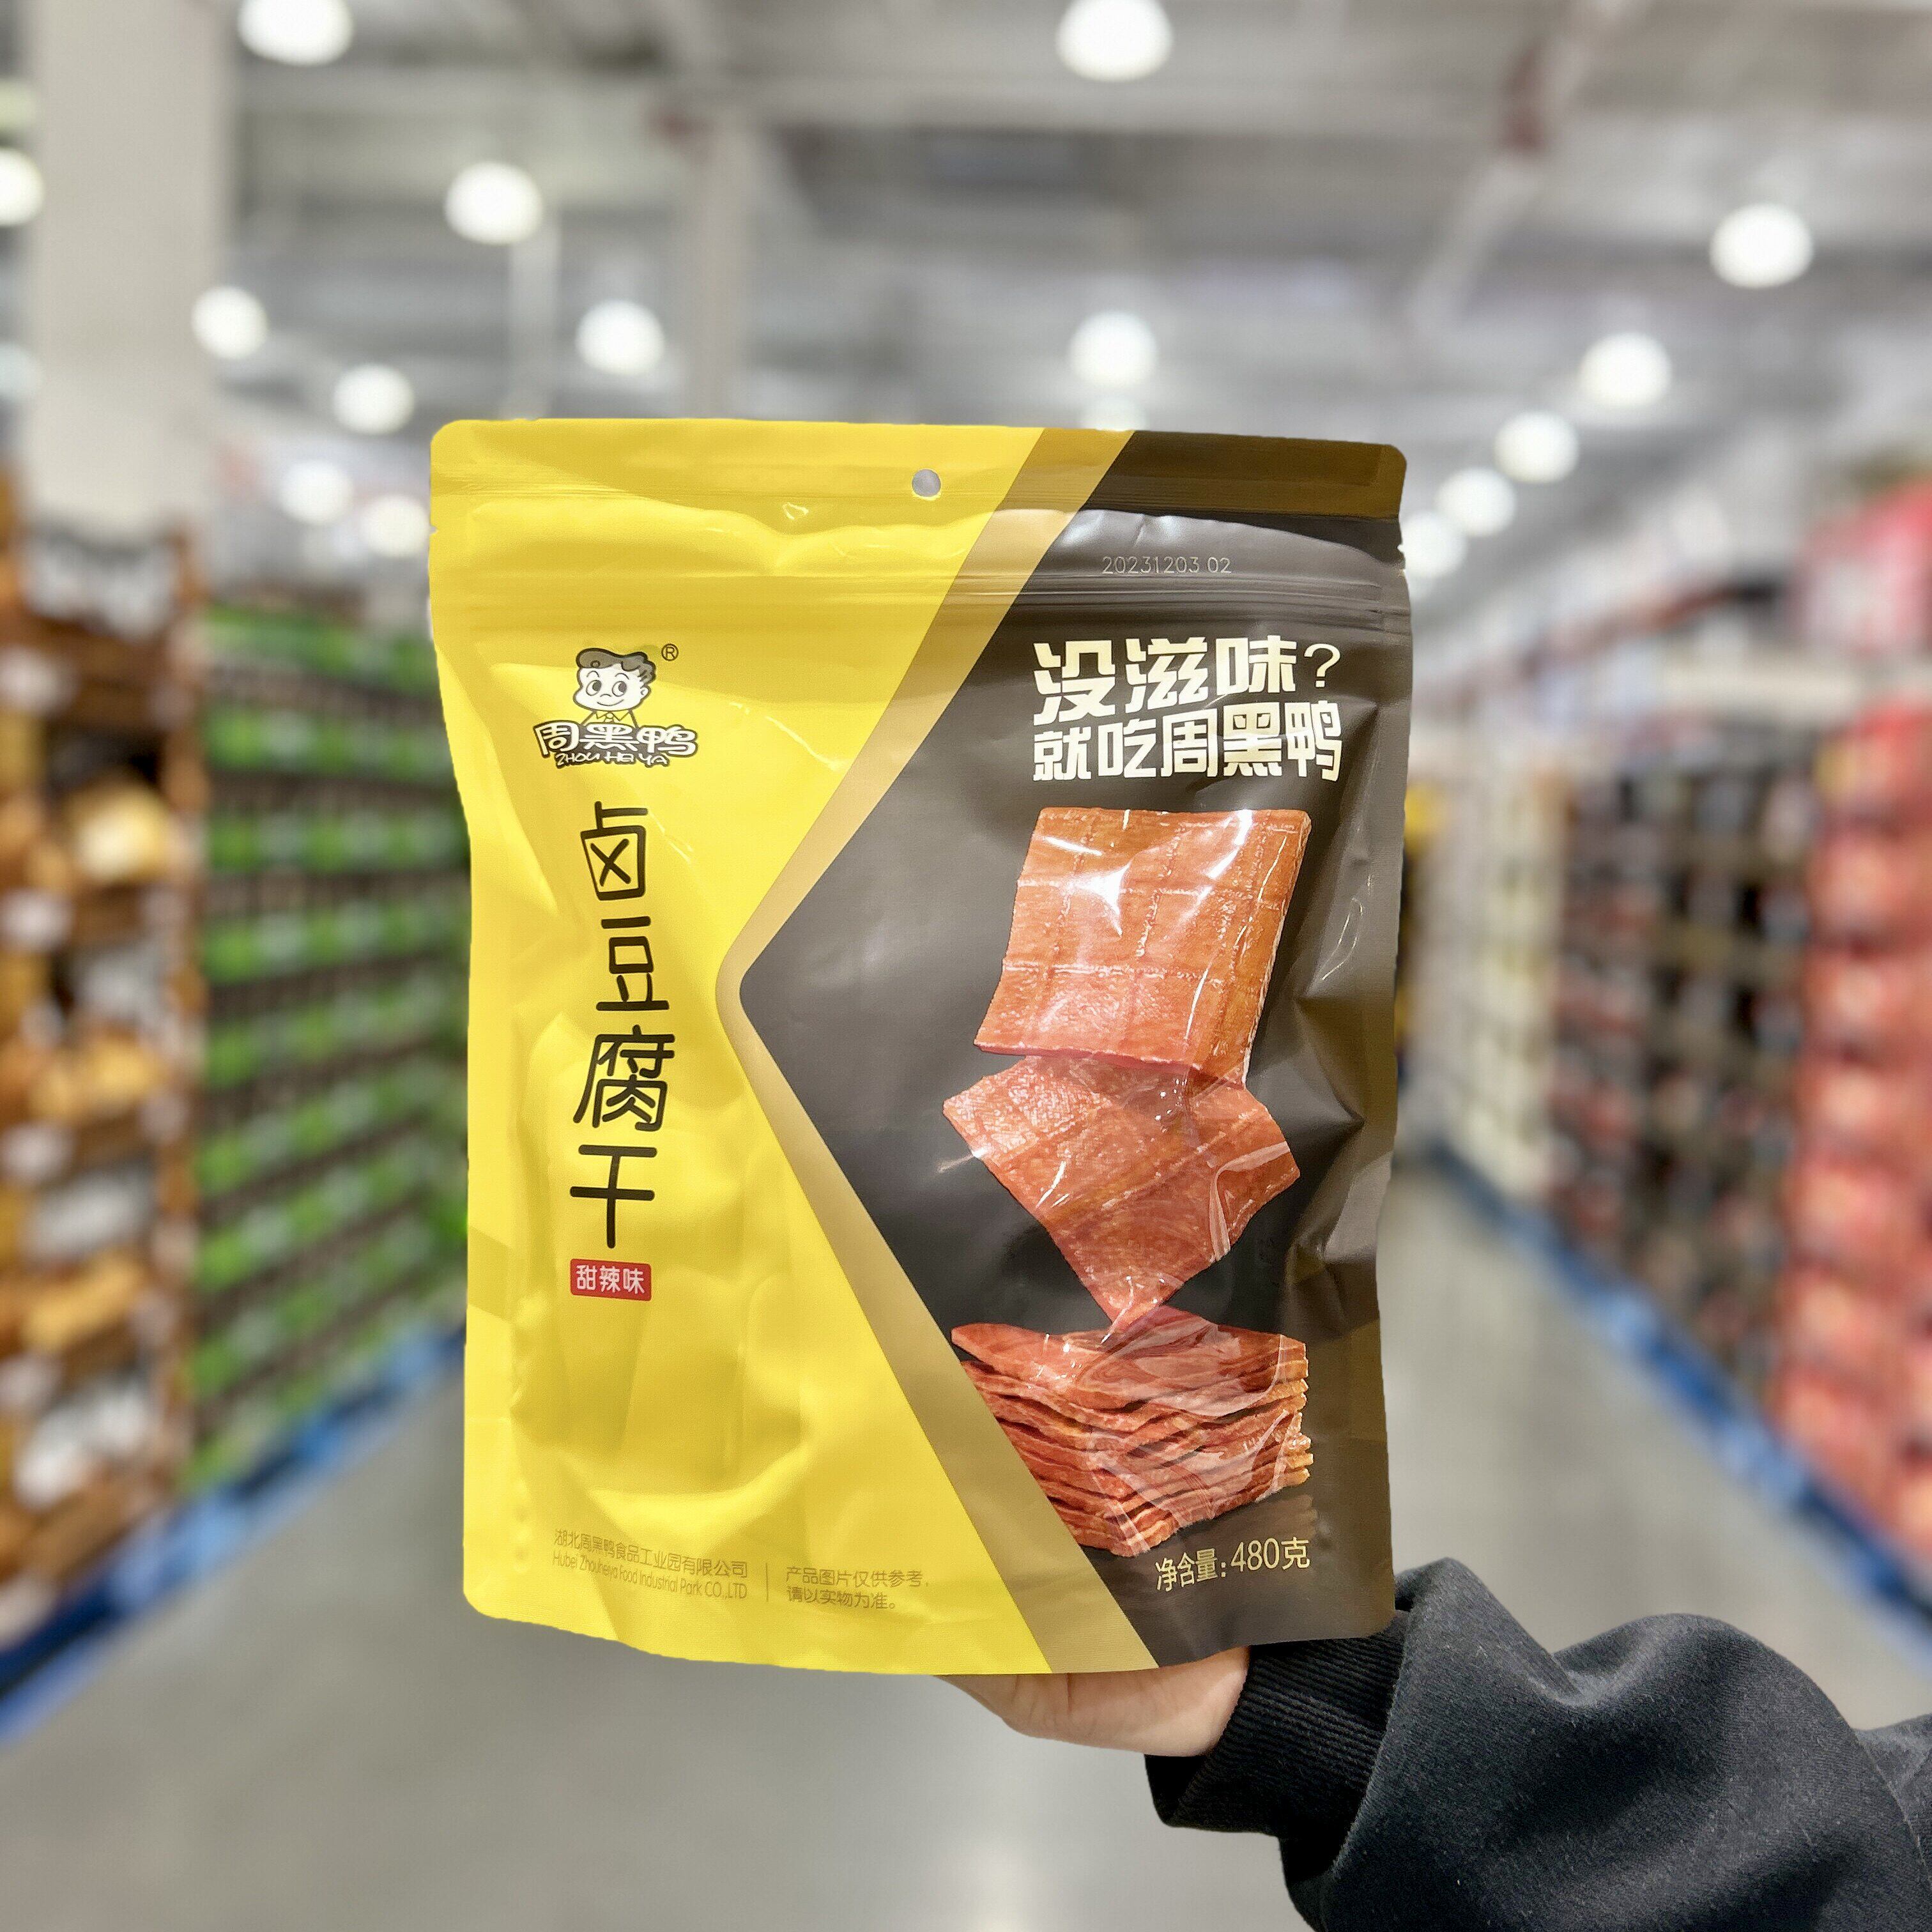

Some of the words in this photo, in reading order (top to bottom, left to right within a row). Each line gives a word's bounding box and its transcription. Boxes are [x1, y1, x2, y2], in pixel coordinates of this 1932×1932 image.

[1101, 555, 1200, 574] 20231203
[1207, 556, 1232, 574] 02
[1032, 634, 1341, 726] 没滋味?
[534, 721, 698, 757] 周黑鸭
[555, 751, 601, 767] ZHOU
[638, 752, 668, 766] YA
[1032, 700, 1343, 782] 就吃周黑鸭
[569, 800, 676, 1249] 卤豆腐干
[576, 1264, 645, 1294] 甜辣味
[552, 1550, 578, 1569] Hubei
[619, 1565, 638, 1584] Food
[640, 1570, 678, 1593] Industrial
[680, 1577, 703, 1595] Park
[553, 1528, 747, 1579] 湖北周黑鸭食品工业园有限公司
[786, 1585, 896, 1610] 请以实物为准。
